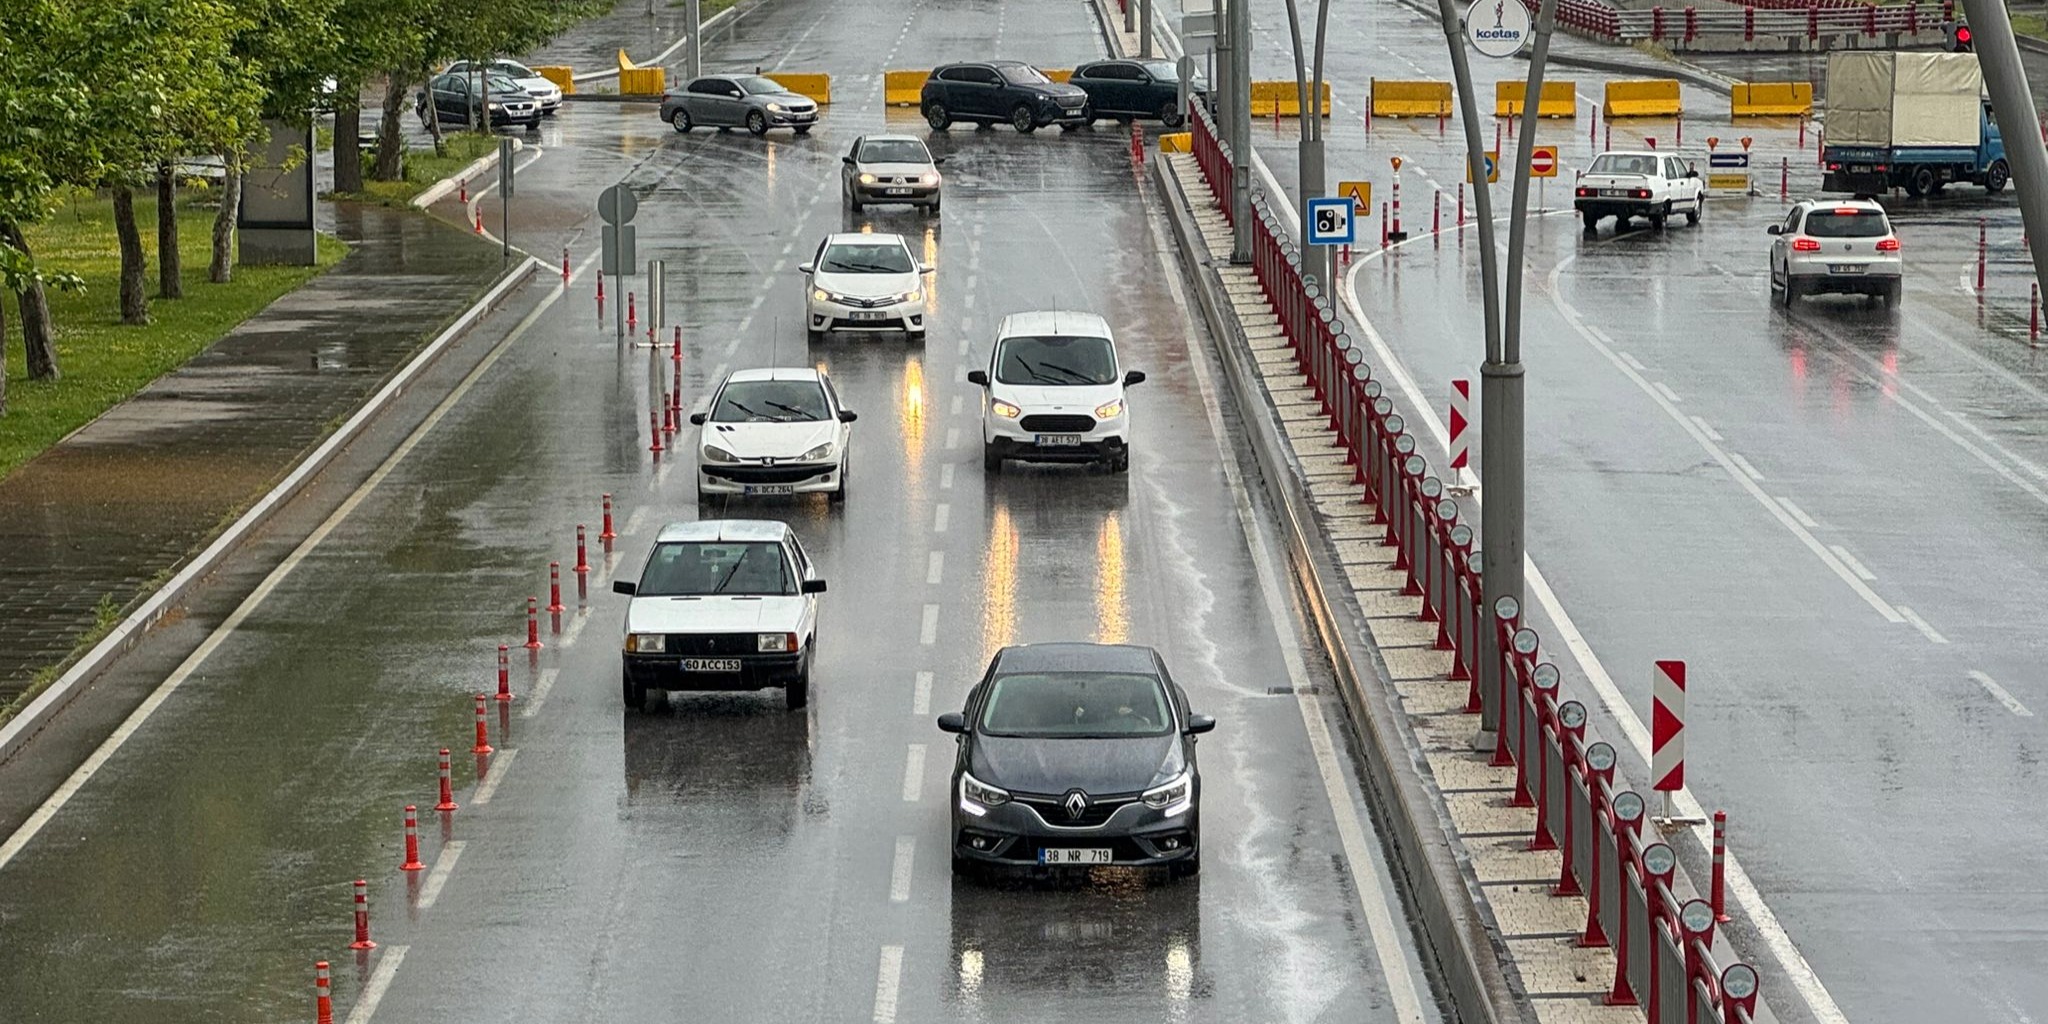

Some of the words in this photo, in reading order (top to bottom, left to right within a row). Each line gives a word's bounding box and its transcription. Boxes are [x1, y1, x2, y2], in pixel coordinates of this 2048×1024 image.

[1046, 850, 1059, 862] 38
[1067, 850, 1081, 862] NR
[1091, 850, 1109, 862] 719
